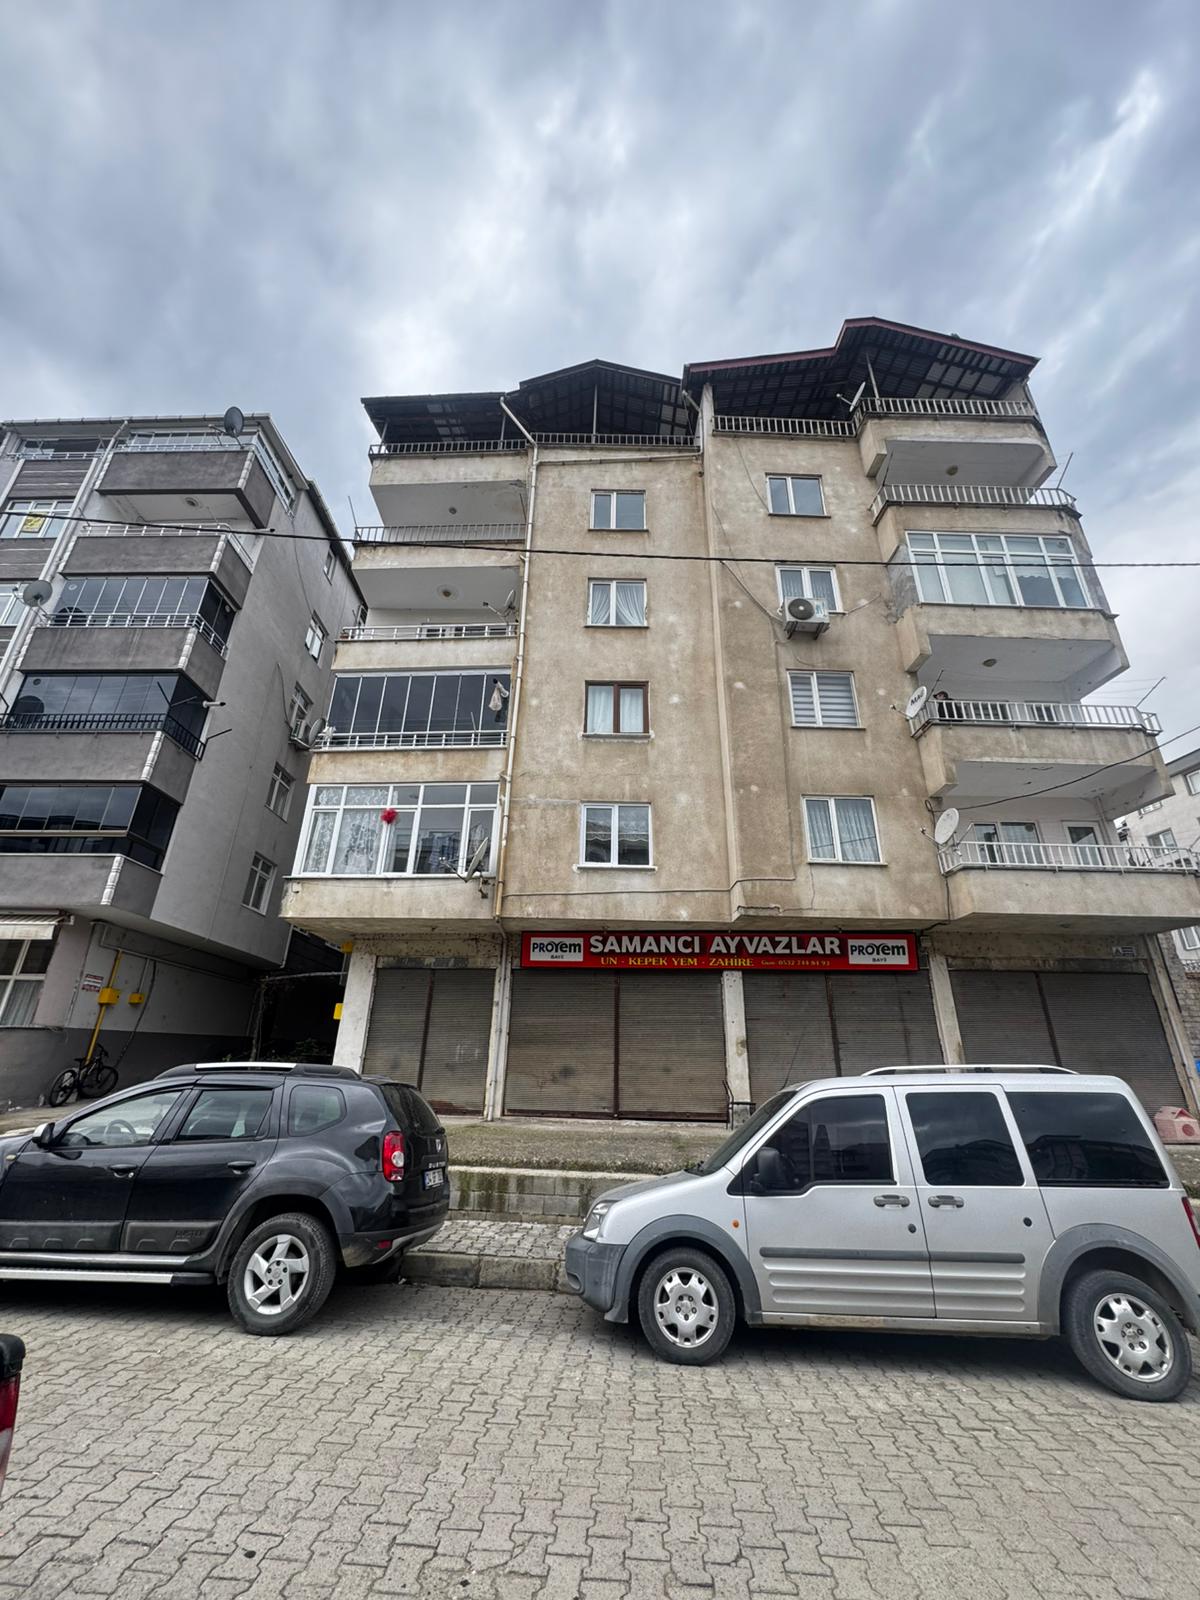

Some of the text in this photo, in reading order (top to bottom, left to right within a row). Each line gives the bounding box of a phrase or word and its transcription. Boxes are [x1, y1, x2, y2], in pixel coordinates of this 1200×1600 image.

[589, 935, 841, 955] SAMANCI AYVAZLAR
[600, 956, 618, 965] UN
[628, 956, 668, 966] KEPEK
[671, 957, 698, 966] YEM
[708, 954, 754, 967] ZAHİRE
